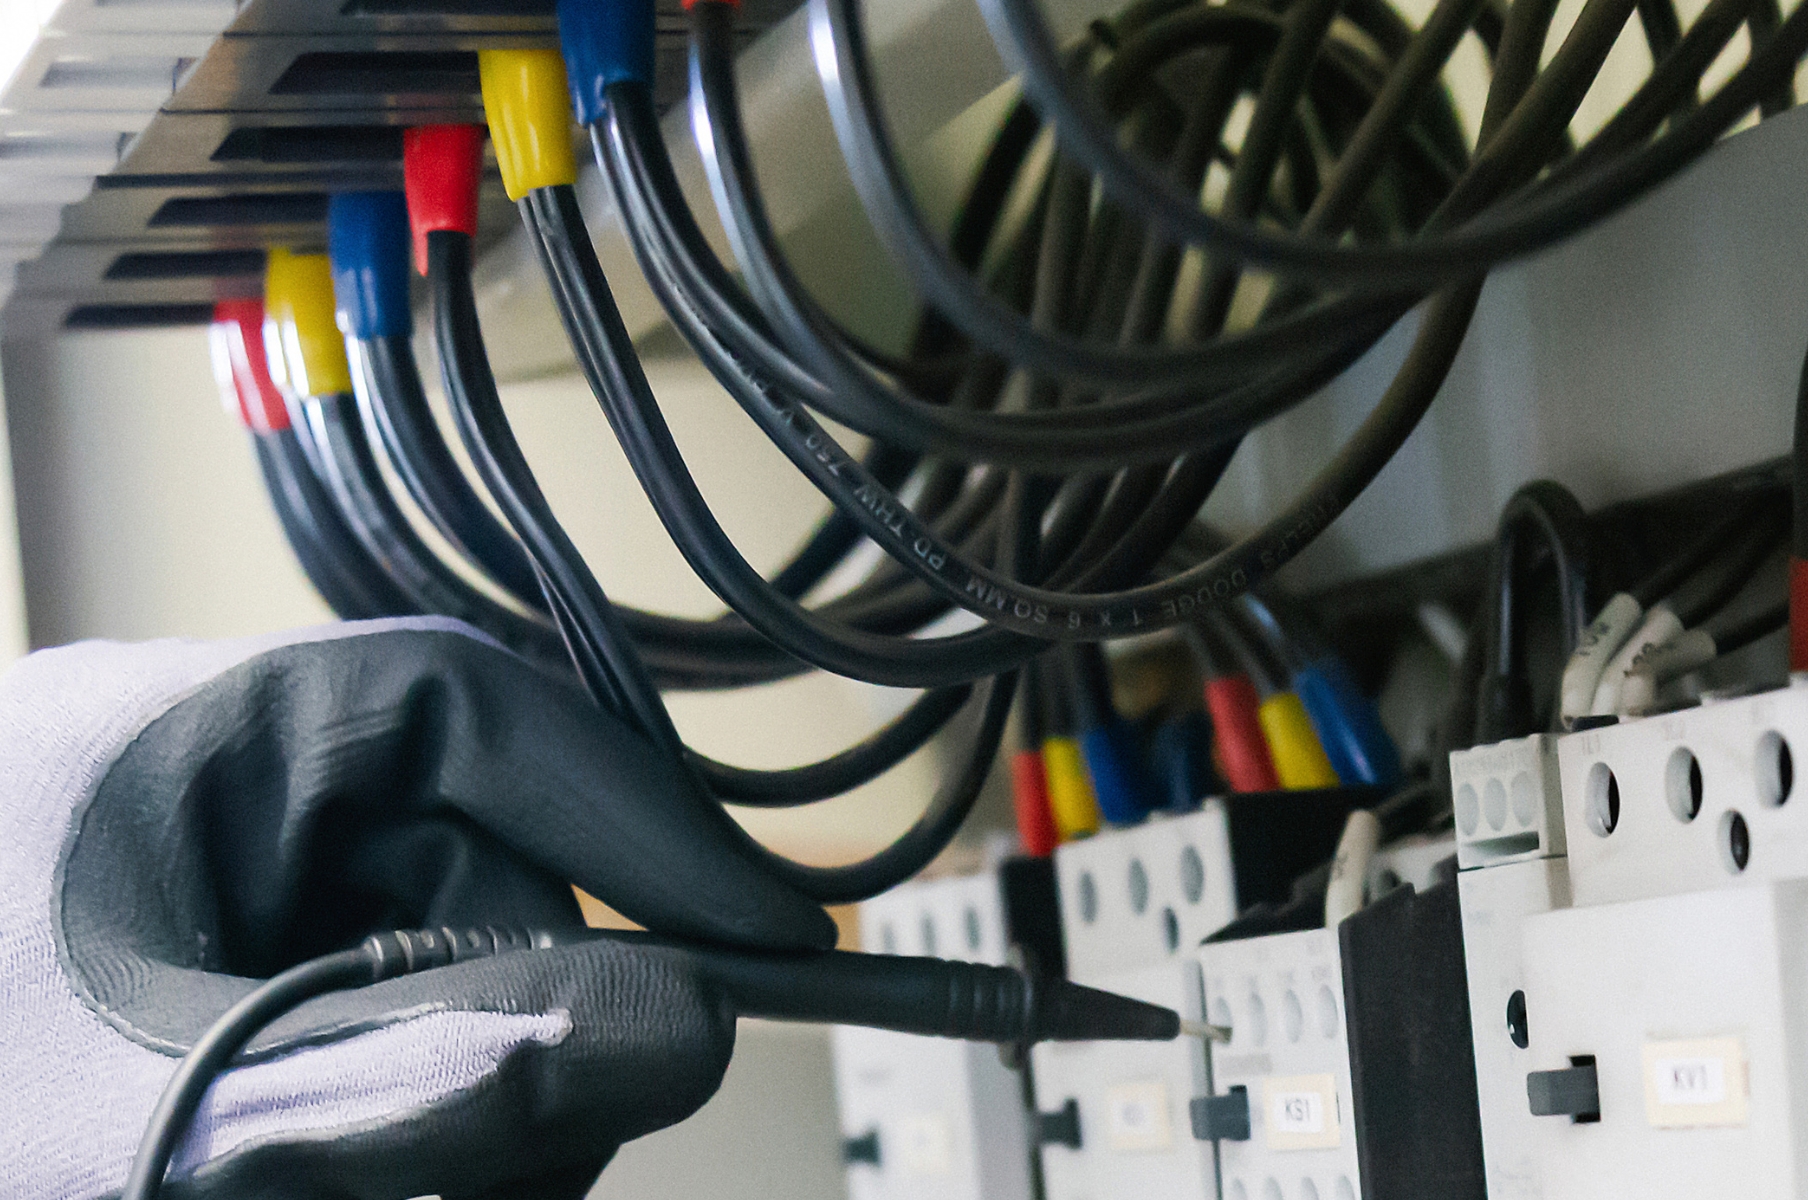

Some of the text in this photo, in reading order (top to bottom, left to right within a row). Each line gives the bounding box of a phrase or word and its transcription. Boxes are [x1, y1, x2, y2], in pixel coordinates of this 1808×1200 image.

[805, 434, 845, 477] 750
[853, 485, 906, 538] THW
[914, 537, 948, 571] PD
[1161, 569, 1247, 617] DODGE
[1068, 612, 1081, 630] 6
[1672, 1064, 1708, 1091] KV1
[1284, 1098, 1311, 1121] KS1
